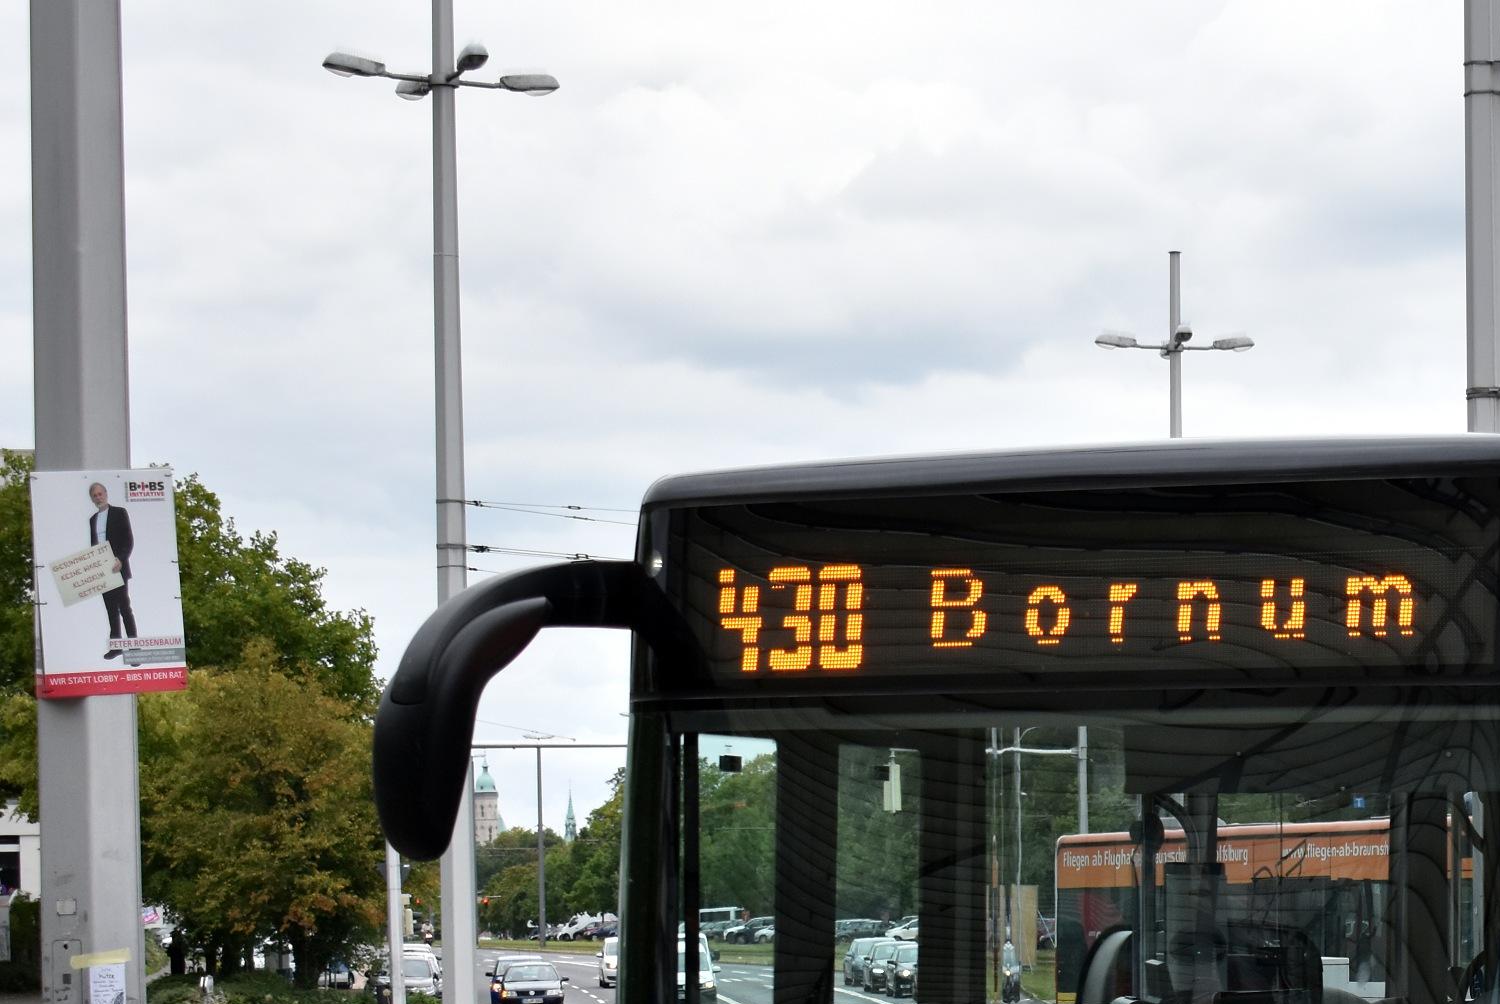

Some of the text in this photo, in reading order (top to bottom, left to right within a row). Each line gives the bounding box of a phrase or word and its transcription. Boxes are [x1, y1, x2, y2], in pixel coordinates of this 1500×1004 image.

[719, 564, 1413, 672] 430 Bornum
[109, 637, 181, 648] PETER ROSENBAUM
[50, 678, 66, 686] WIR
[68, 676, 92, 685] STATT
[94, 674, 118, 683] LOBBY
[126, 673, 142, 681] BIBS
[153, 671, 168, 680] DEN
[1063, 850, 1090, 870] Fliegen
[1092, 850, 1102, 866] ab
